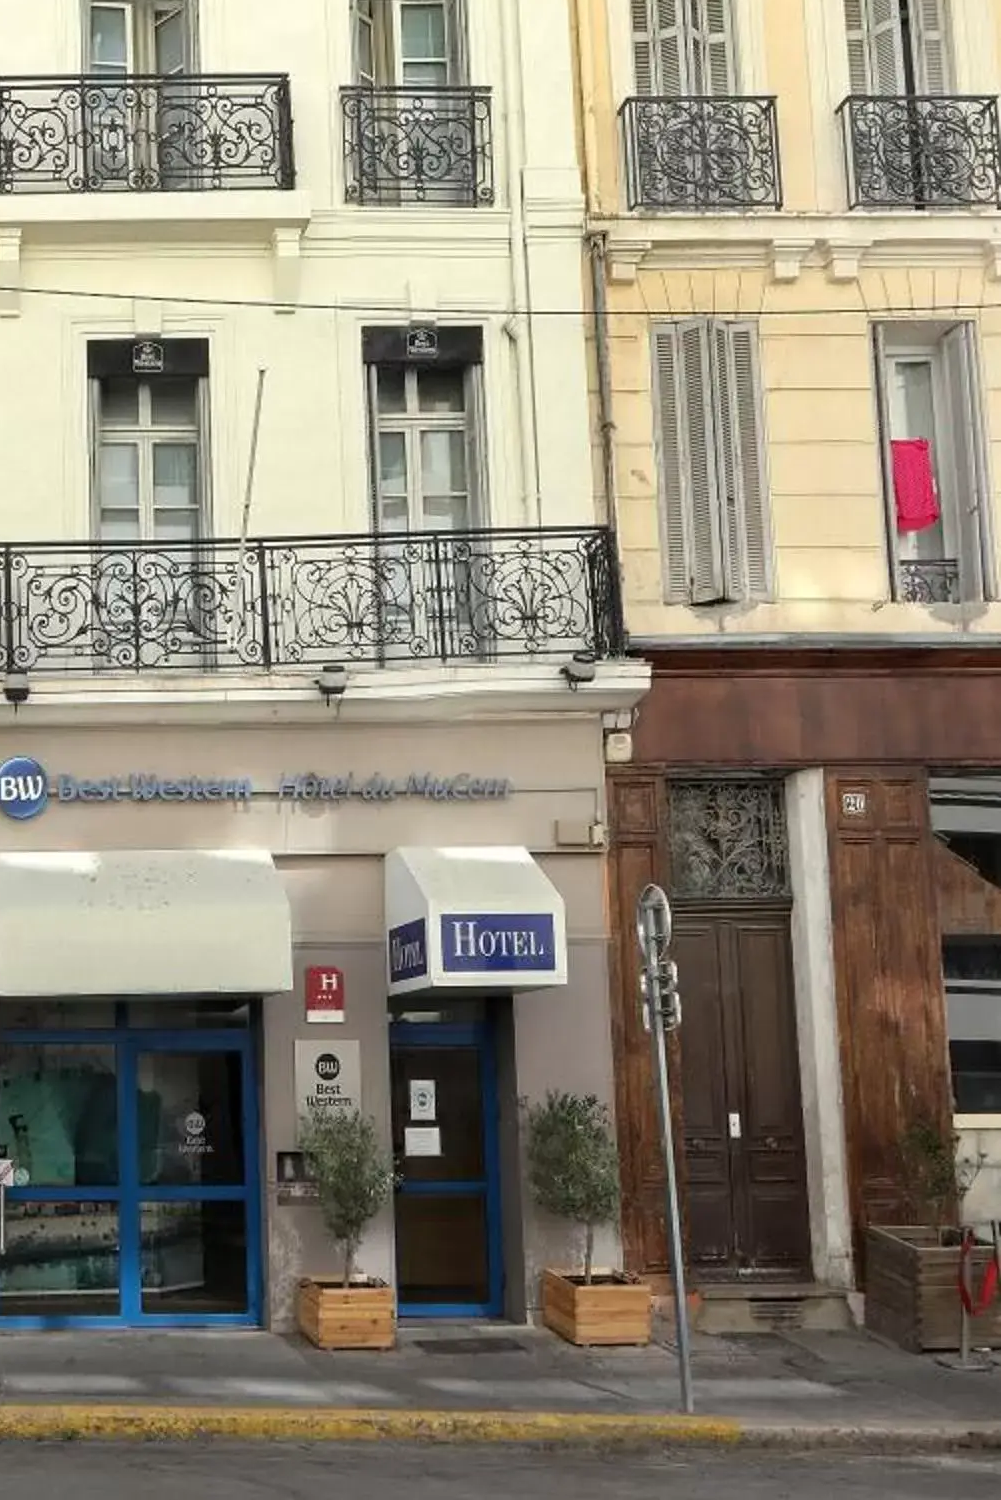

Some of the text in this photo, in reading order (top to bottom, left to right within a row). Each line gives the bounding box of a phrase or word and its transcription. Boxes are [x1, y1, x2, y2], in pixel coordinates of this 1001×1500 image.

[0, 775, 44, 801] BW
[57, 773, 124, 801] Best
[129, 772, 254, 801] Western
[321, 973, 338, 991] H
[316, 1083, 342, 1095] Best
[306, 1095, 352, 1108] Western
